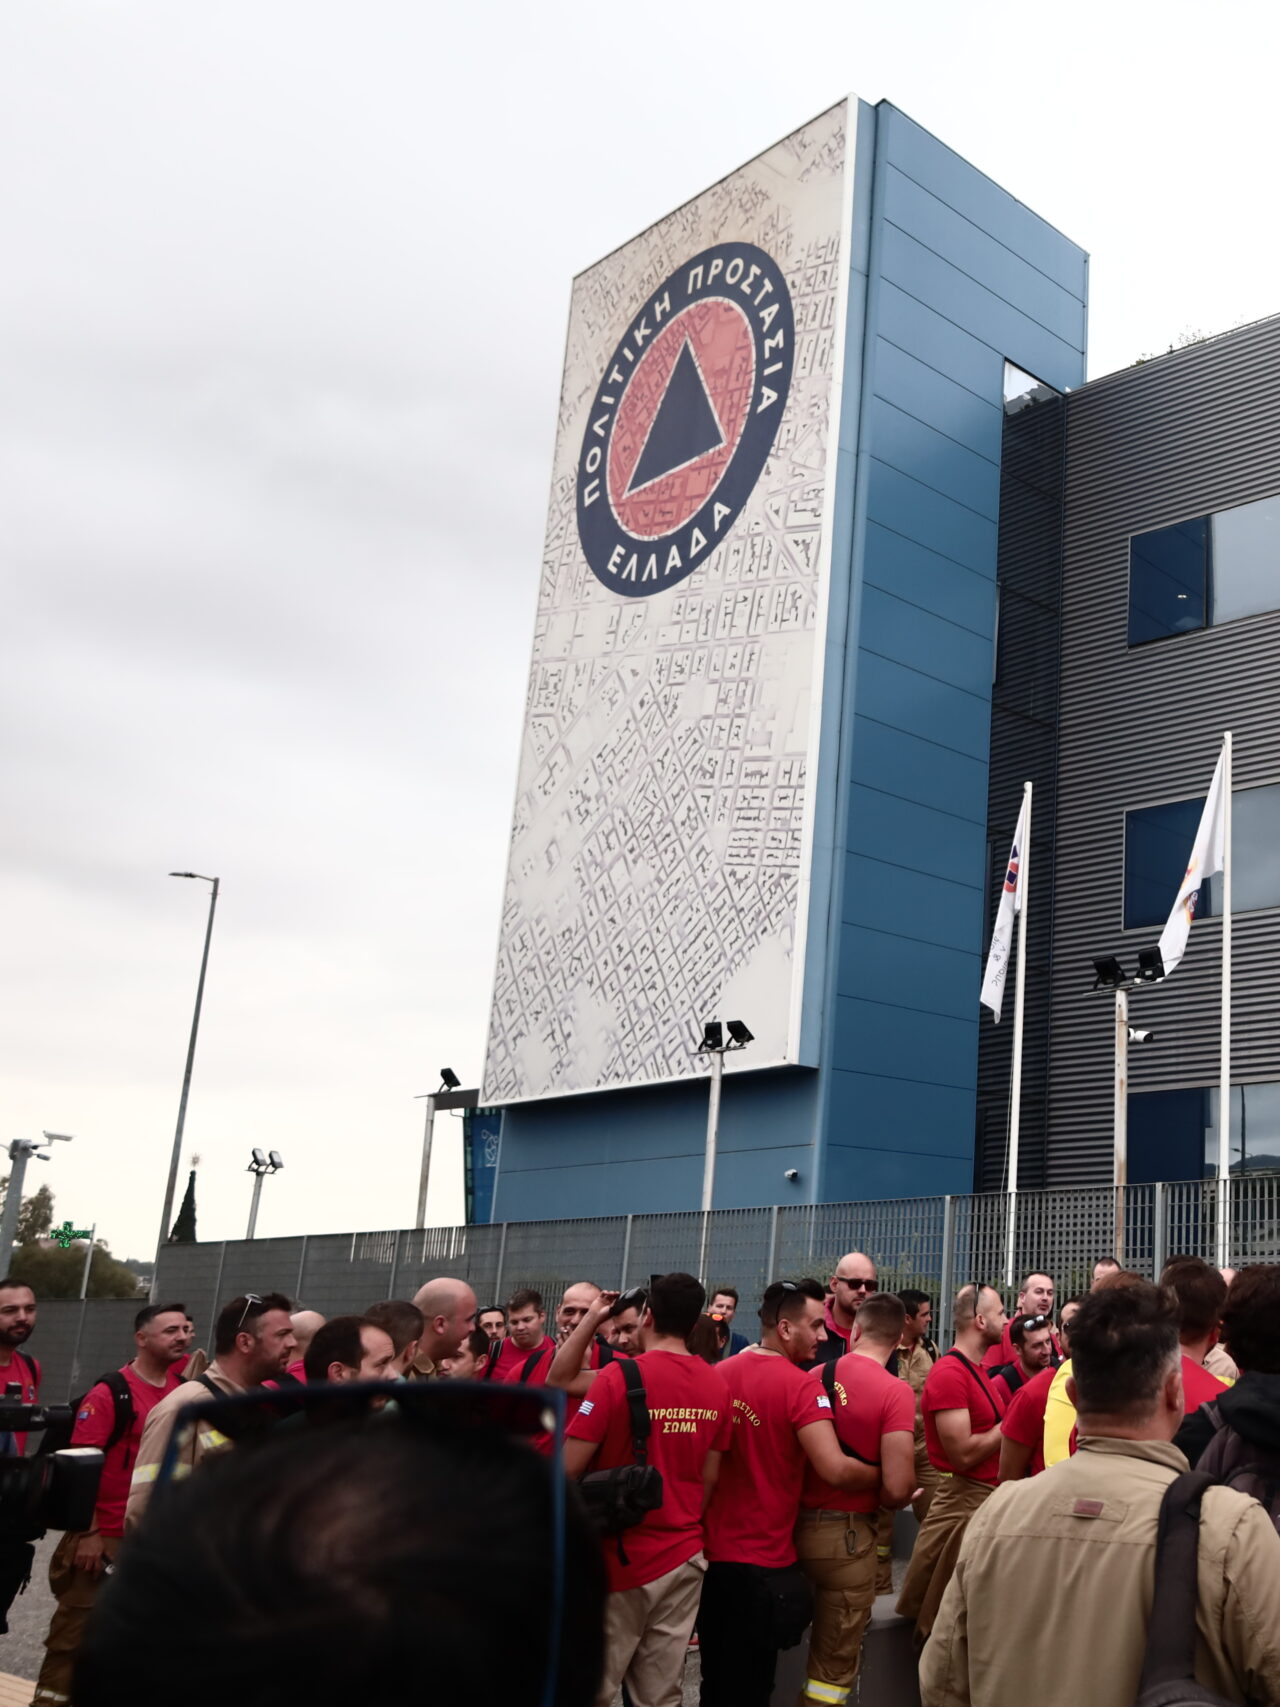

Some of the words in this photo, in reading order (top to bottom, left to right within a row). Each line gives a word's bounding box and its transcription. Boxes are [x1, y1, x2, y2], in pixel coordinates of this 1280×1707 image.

[584, 291, 671, 507] ΠΟΛΙΤΙΚΗ
[687, 258, 784, 414] ΠΡΟΣΤΑΣΙΑ
[606, 501, 732, 582] ΕΛΛΑΔΑ
[662, 1421, 698, 1434] ΣΩΜΑ
